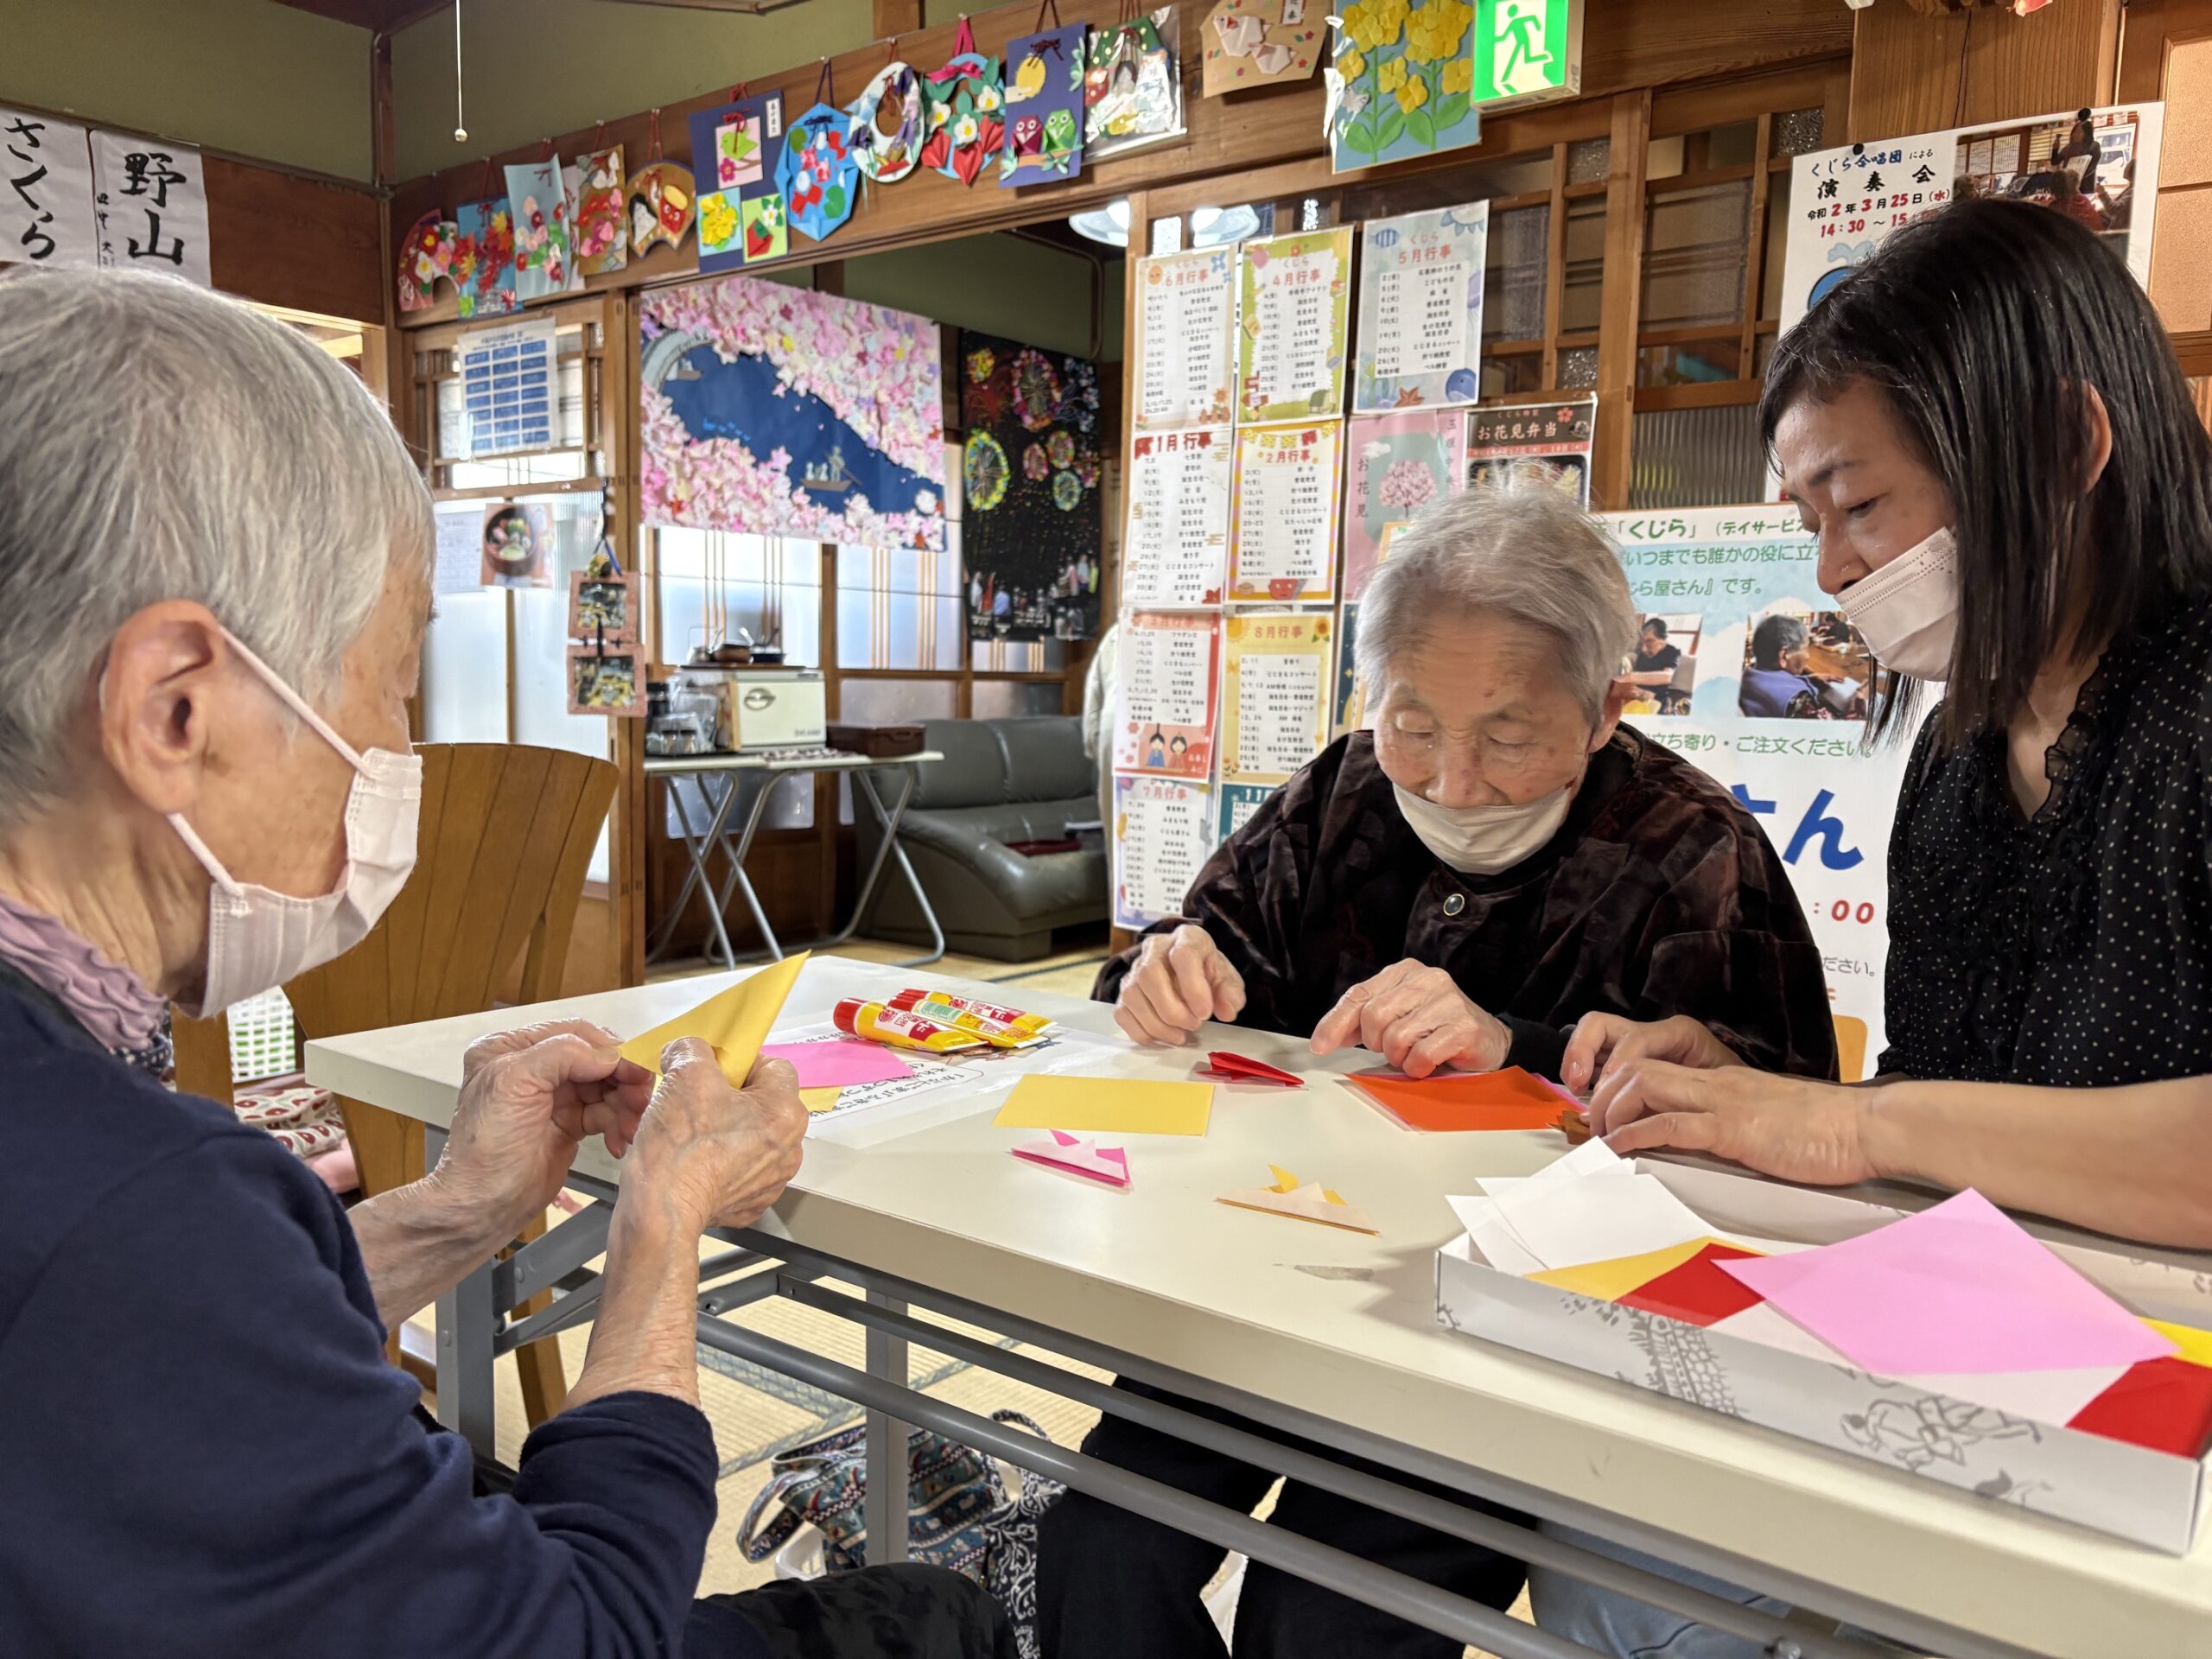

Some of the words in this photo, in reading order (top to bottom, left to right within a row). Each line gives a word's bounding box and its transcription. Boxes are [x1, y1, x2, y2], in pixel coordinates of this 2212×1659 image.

[1811, 149, 1903, 177] くじら合唱団
[3, 117, 55, 259] さくら
[119, 152, 187, 265] 野山
[1410, 231, 1439, 245] くじら
[1283, 257, 1310, 268] くじら
[1398, 244, 1452, 264] 5月行事
[1165, 269, 1209, 287] 6月行事
[1273, 268, 1321, 287] 4月行事
[1478, 421, 1557, 441] お花見弁当
[1266, 449, 1312, 464] 2月行事
[1357, 458, 1370, 518] お花見
[1618, 518, 1696, 540] 「くじら」
[1624, 543, 1818, 566] いつまでも誰かの役に立
[1255, 625, 1304, 639] 8月行事
[1645, 733, 1872, 759] 立ち寄り・ご注文ください。
[1142, 785, 1187, 801] 7月行事
